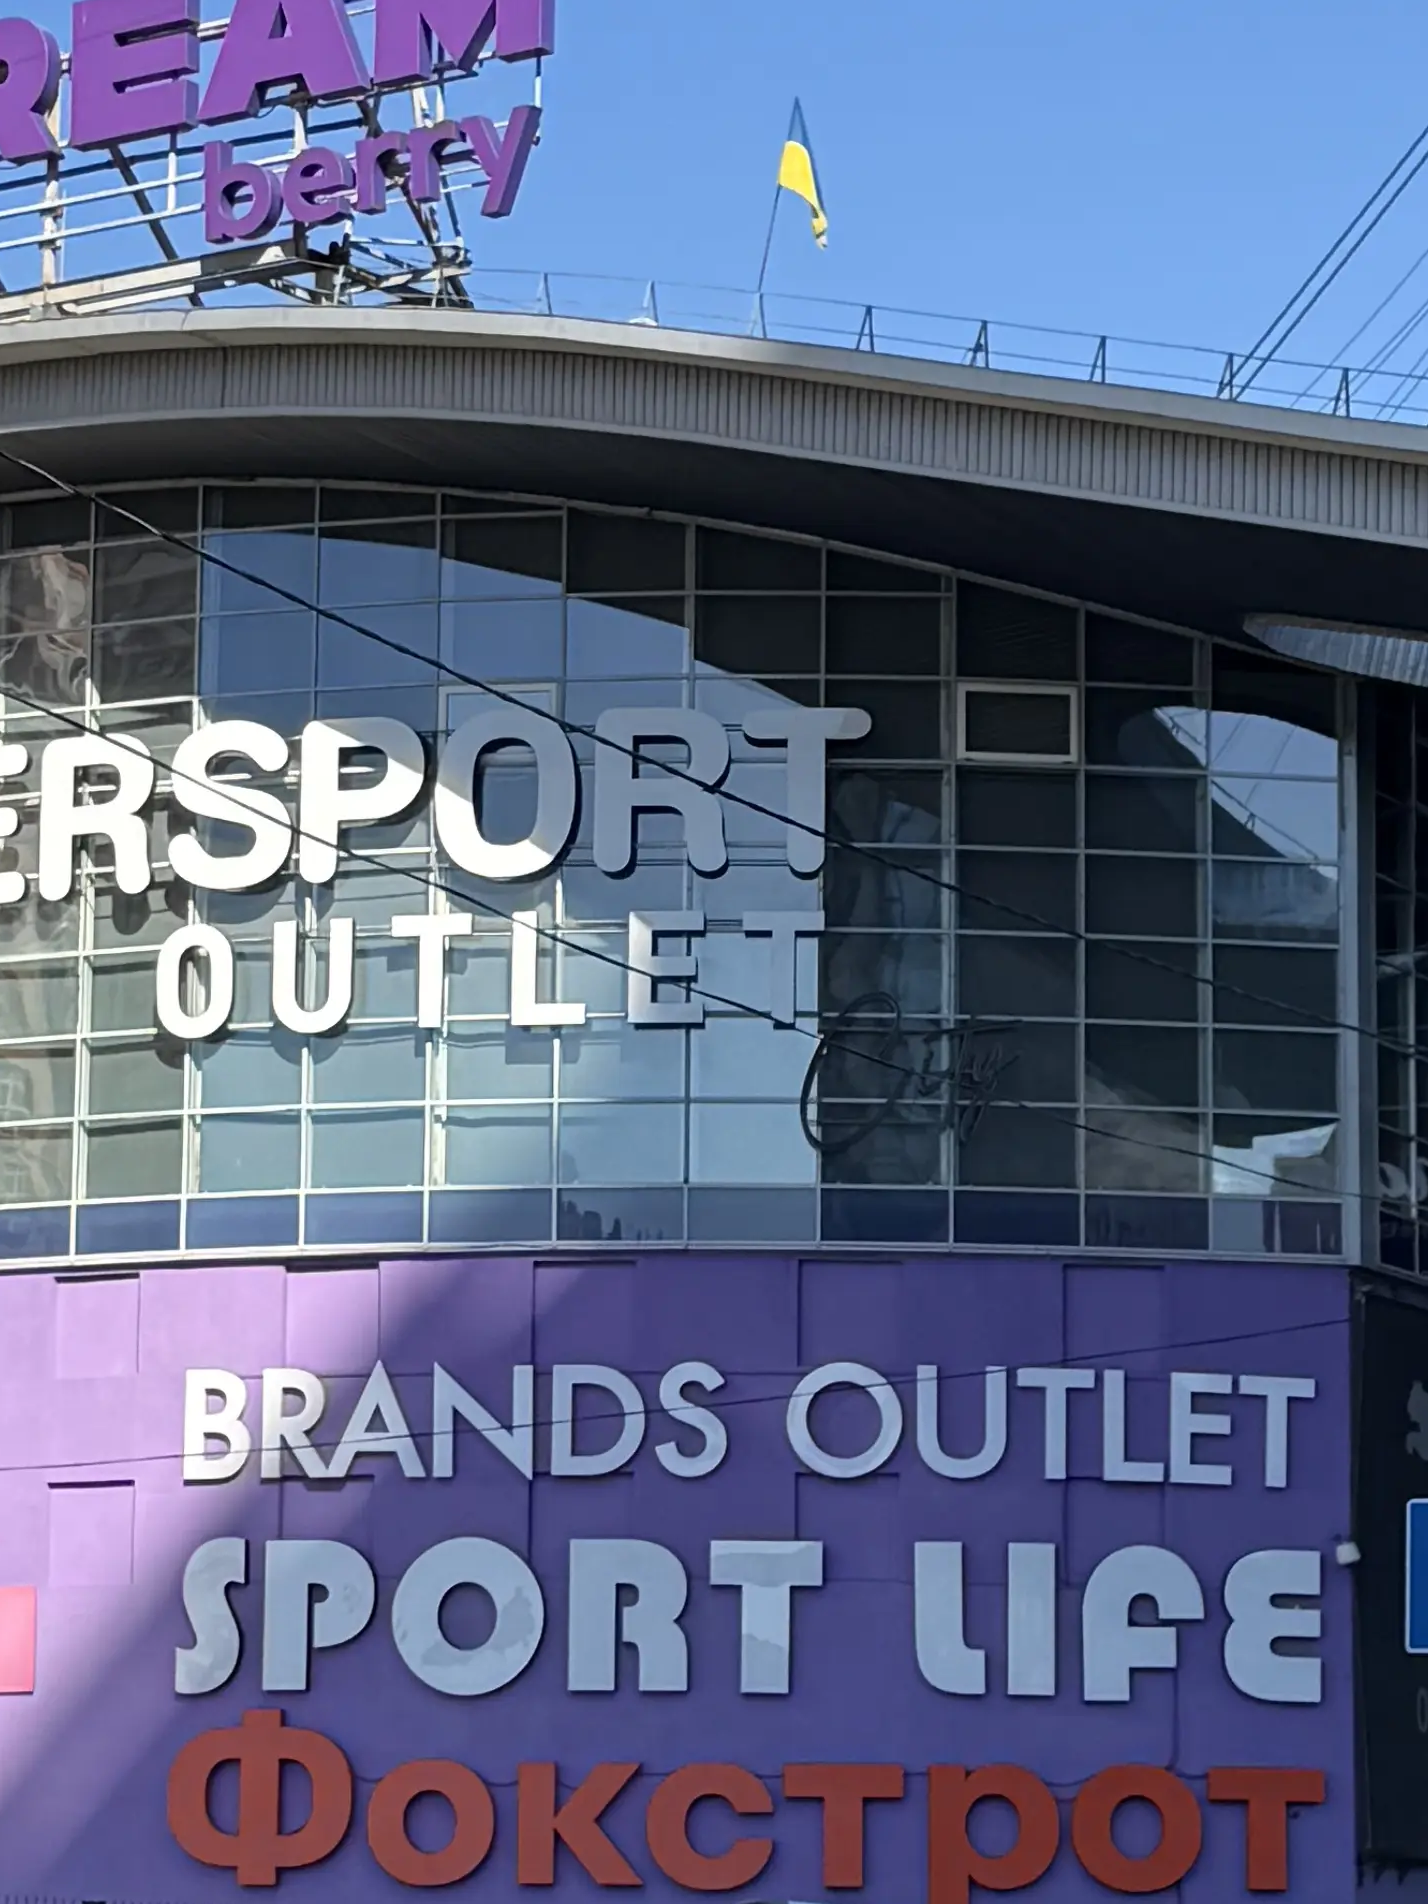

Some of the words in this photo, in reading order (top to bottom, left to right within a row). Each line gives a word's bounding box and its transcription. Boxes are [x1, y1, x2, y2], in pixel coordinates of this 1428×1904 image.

[203, 105, 541, 244] berry
[154, 910, 826, 1040] OUTLET
[181, 1361, 728, 1484] BRANDS
[785, 1361, 1318, 1490] OUTLET
[174, 1536, 824, 1696] SPORT
[912, 1539, 1322, 1703] LIFE
